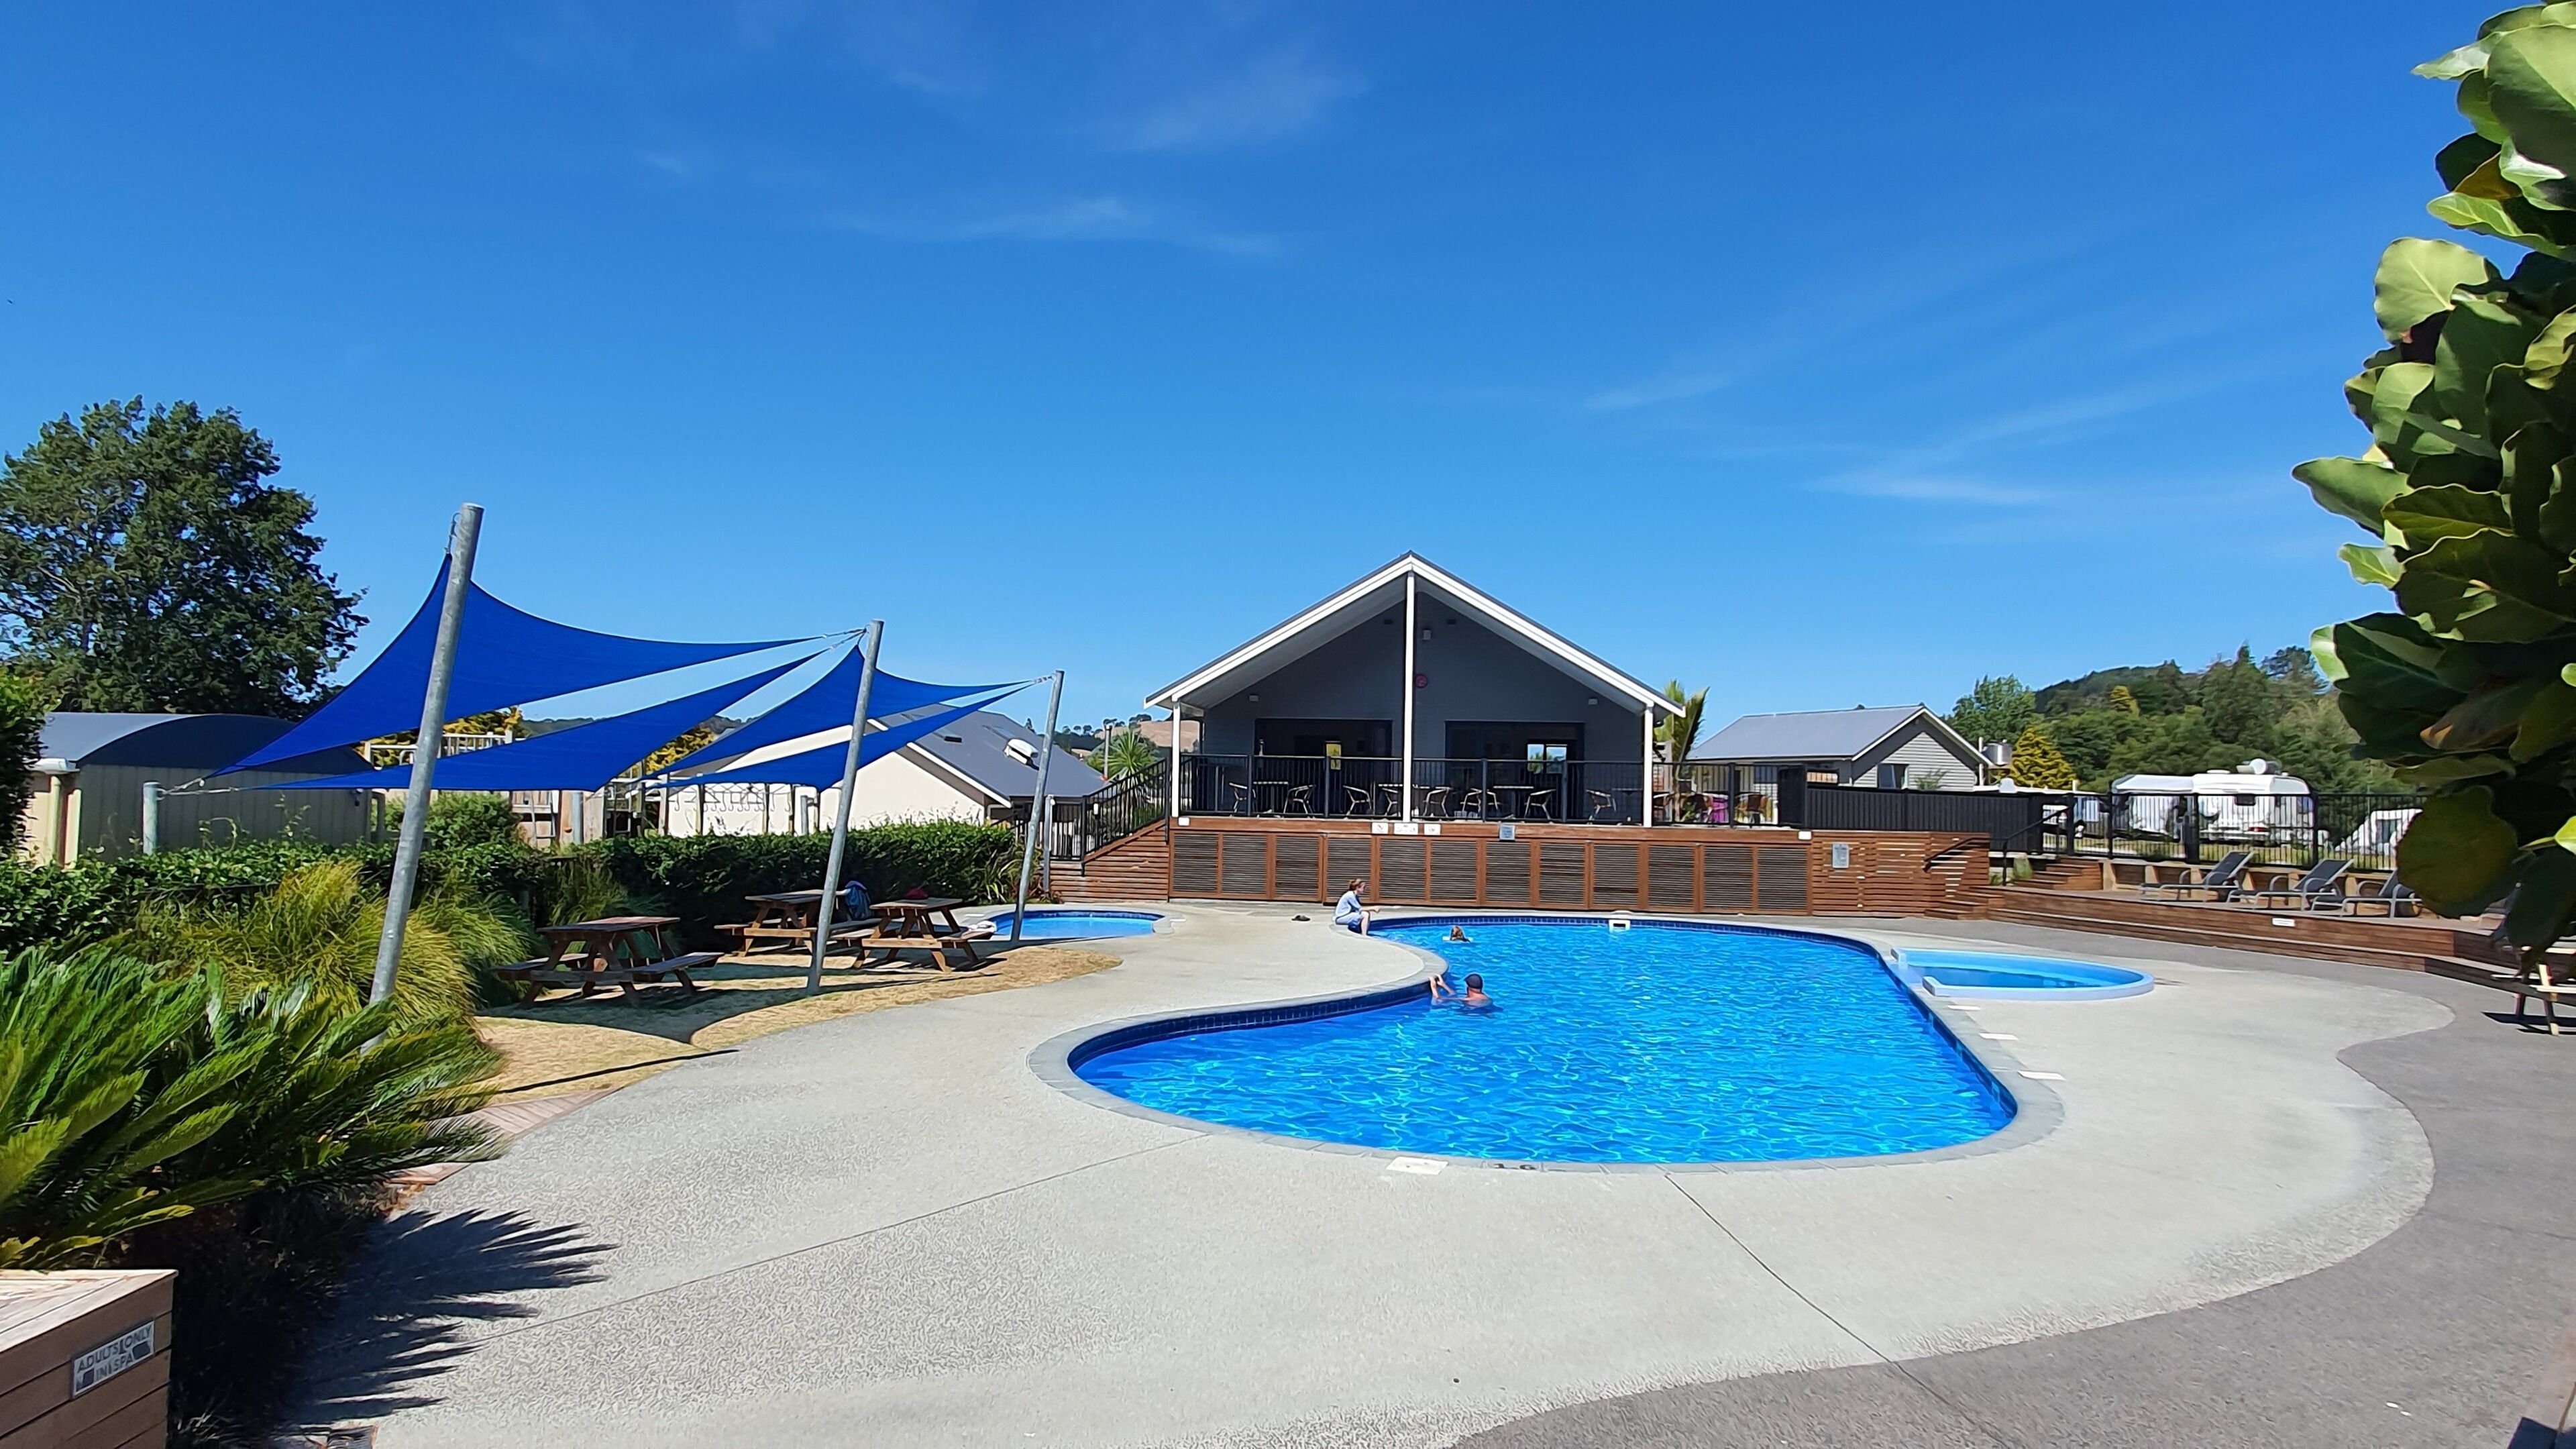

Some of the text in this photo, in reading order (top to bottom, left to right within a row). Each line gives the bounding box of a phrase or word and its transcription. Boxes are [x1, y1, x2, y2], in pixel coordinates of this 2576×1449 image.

[77, 1325, 152, 1373] ADULTS ONLY
[113, 1354, 133, 1371] SPA
